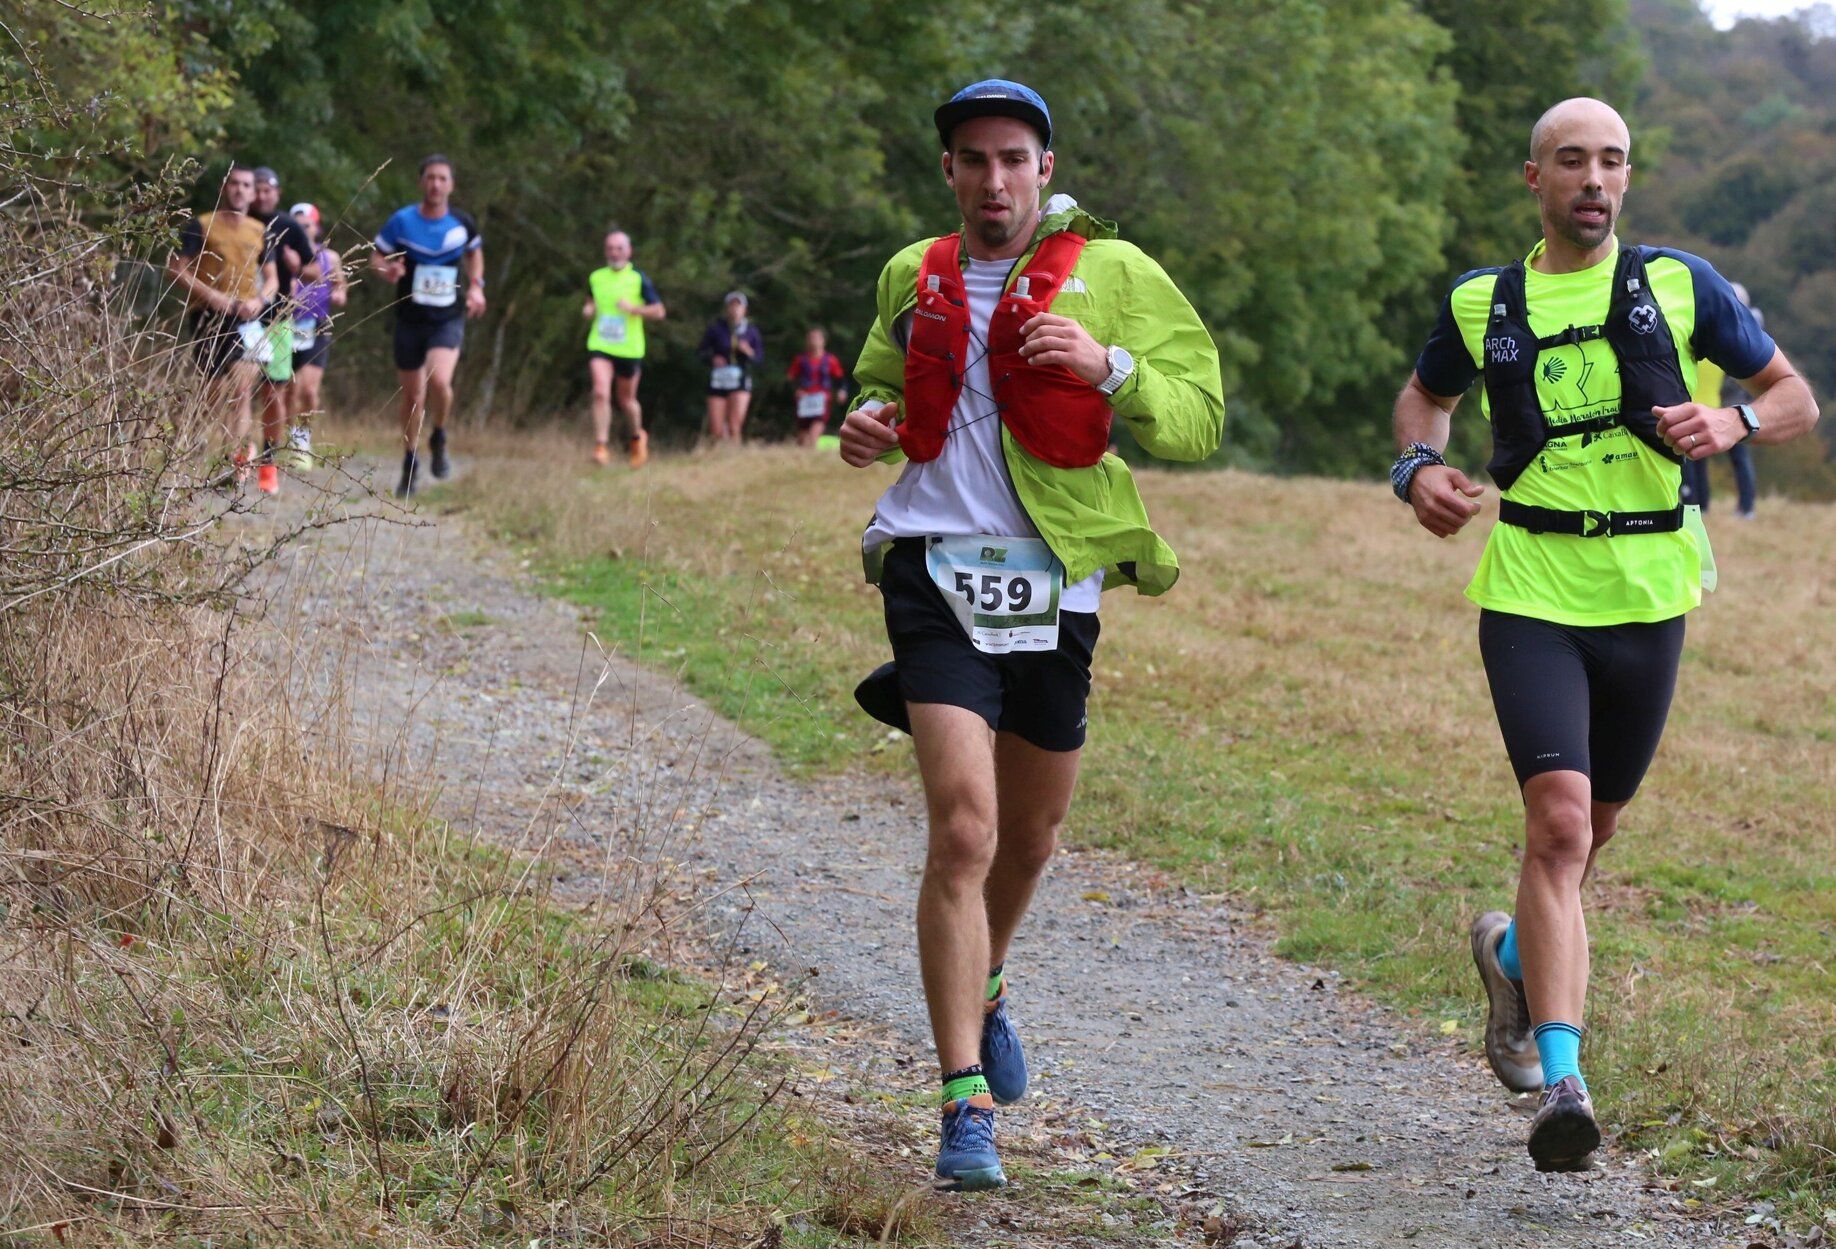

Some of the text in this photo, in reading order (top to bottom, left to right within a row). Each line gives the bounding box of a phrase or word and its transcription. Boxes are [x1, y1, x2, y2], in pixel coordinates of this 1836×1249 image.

[1491, 349, 1520, 363] MAX
[1625, 519, 1654, 527] APTONIA
[954, 571, 1032, 612] 559
